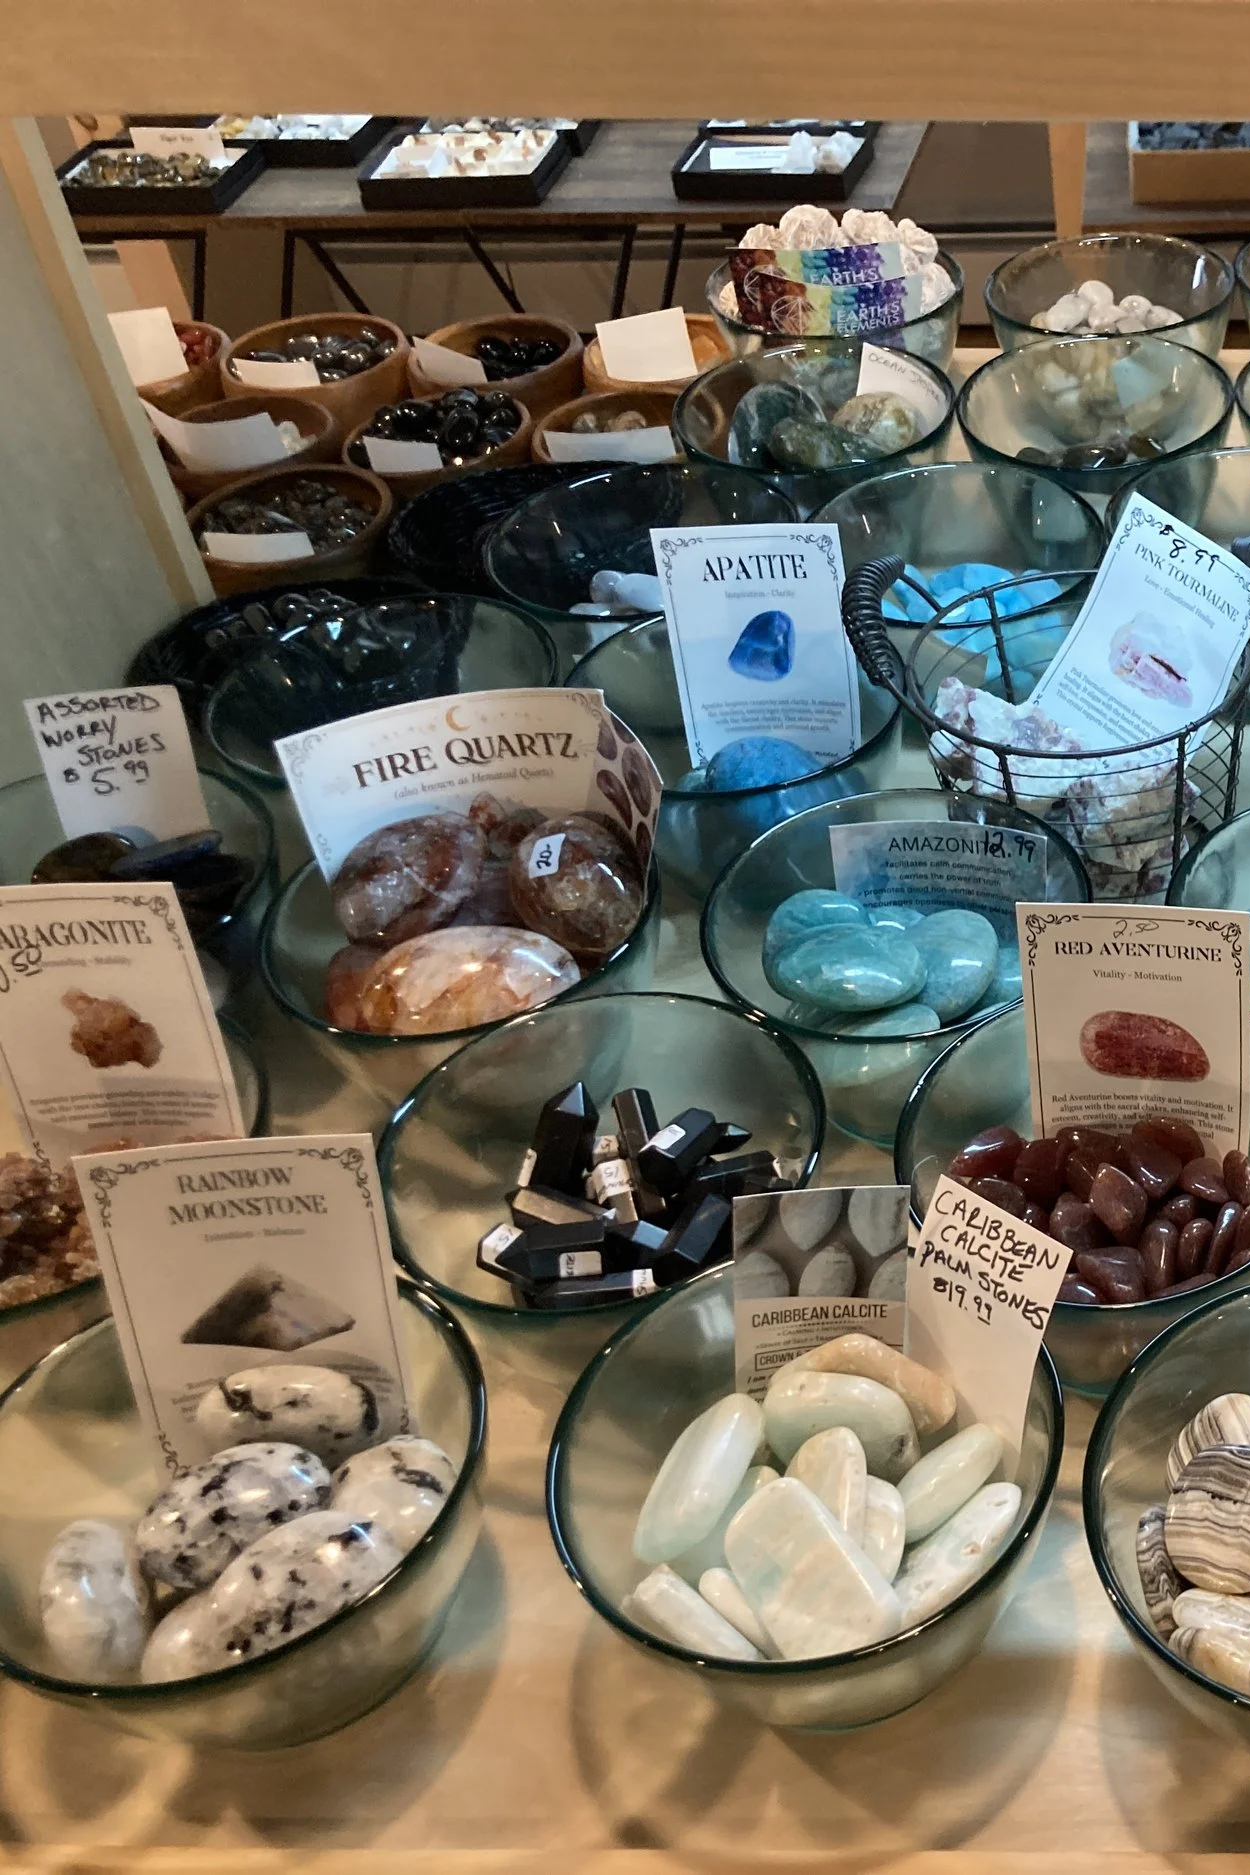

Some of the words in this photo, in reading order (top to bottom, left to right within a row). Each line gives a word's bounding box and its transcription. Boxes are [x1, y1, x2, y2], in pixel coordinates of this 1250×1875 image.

[703, 554, 808, 582] APATITE
[1134, 543, 1163, 571] PINK
[1167, 562, 1240, 623] TOURMALINE
[36, 692, 161, 725] ASSORTED
[40, 714, 117, 748] WORRY
[78, 732, 166, 767] STONES
[351, 743, 440, 789] FIRE
[445, 732, 580, 767] QUARTZ
[0, 919, 152, 949] ARAGONITE
[1054, 941, 1093, 956] RED
[1100, 942, 1222, 963] AVENTURINE
[1092, 969, 1127, 981] Vitality
[1134, 971, 1183, 983] Motivation
[1052, 1095, 1067, 1104] Red
[1069, 1093, 1112, 1102] Aventurine
[1113, 1093, 1138, 1102] boosts
[1140, 1094, 1166, 1105] vitality
[1168, 1096, 1182, 1104] and
[1184, 1098, 1226, 1112] motivation.
[1060, 1102, 1083, 1113] aligns
[1084, 1102, 1102, 1111] with
[1103, 1102, 1116, 1111] the
[1117, 1103, 1140, 1111] sacral
[1141, 1103, 1168, 1114] chakra,
[1171, 1107, 1209, 1120] enhancing
[1122, 1113, 1137, 1121] and
[1199, 1119, 1214, 1128] This
[1215, 1123, 1235, 1134] stone
[176, 1167, 293, 1195] RAINBOW
[168, 1194, 328, 1226] MOONSTONE
[935, 1190, 1060, 1270] CARIBBEAN
[940, 1224, 1034, 1283] CALCITE
[919, 1240, 973, 1281] PALM
[977, 1270, 1050, 1331] STONES
[752, 1305, 830, 1328] CARIBBEAN
[832, 1303, 888, 1319] CALCITE
[759, 1352, 794, 1367] CROWN
